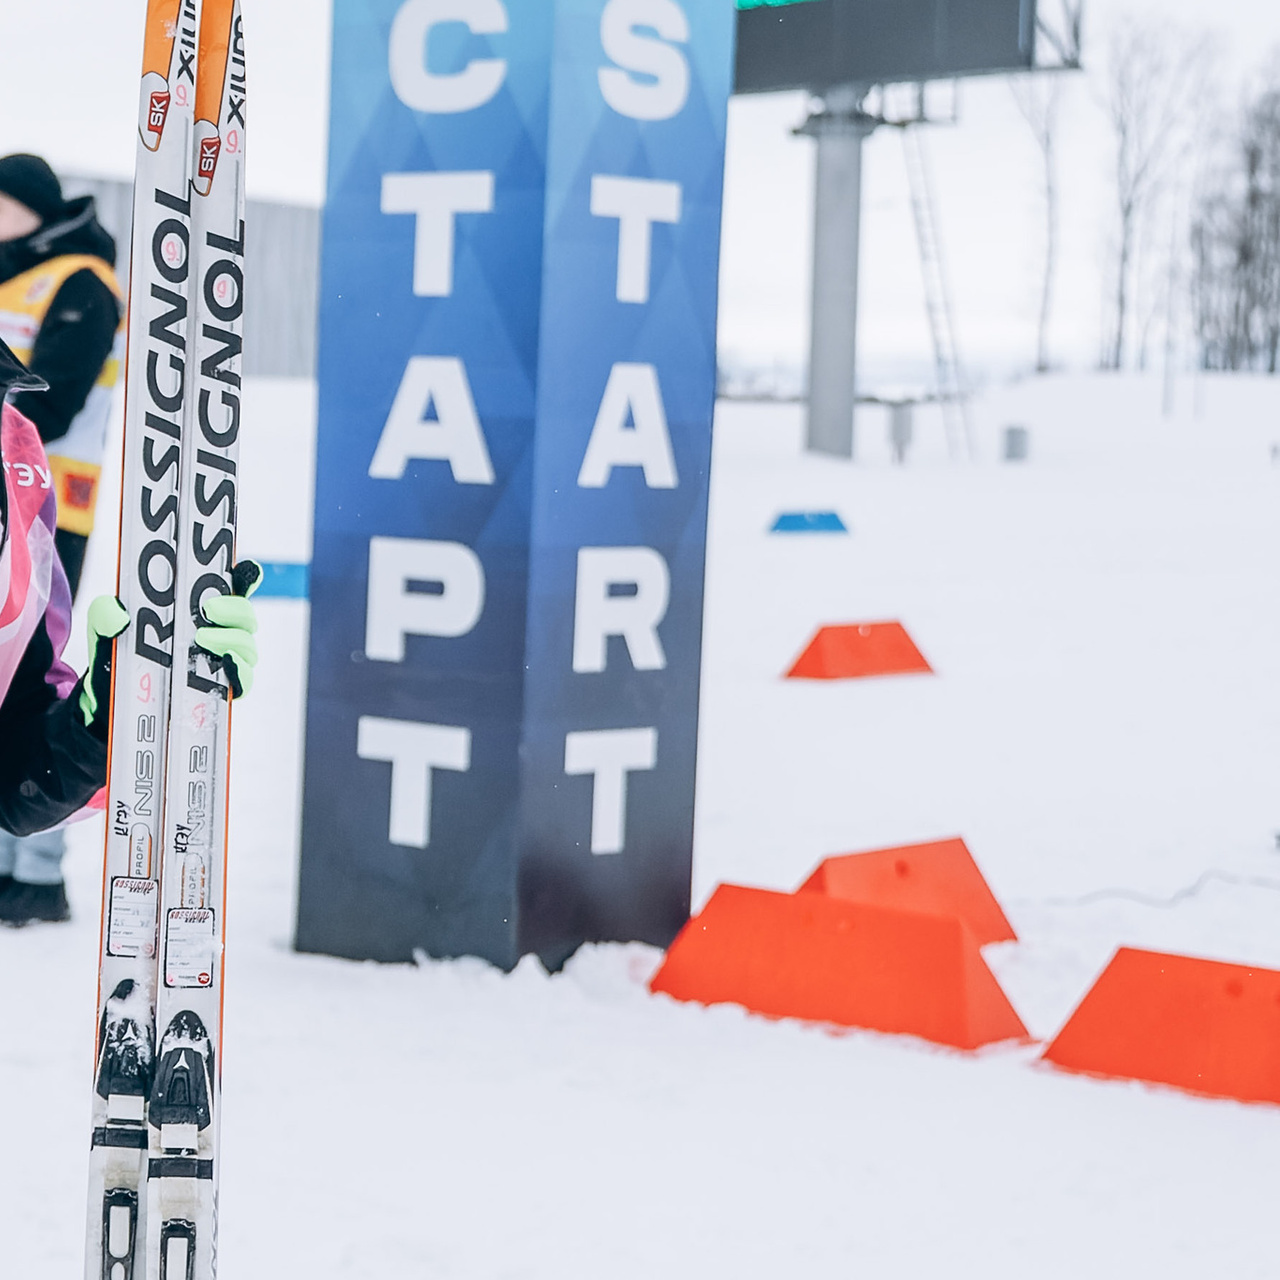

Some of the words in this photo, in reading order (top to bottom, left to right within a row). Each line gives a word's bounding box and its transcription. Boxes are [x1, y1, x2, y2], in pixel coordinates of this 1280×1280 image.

[134, 179, 193, 669] ROSSIGNOL
[186, 219, 245, 703] ROSSIGNOL
[136, 714, 156, 743] 2
[189, 745, 208, 773] 2
[133, 750, 155, 817] NIS
[186, 781, 207, 846] NIS
[135, 835, 145, 876] PROFIL
